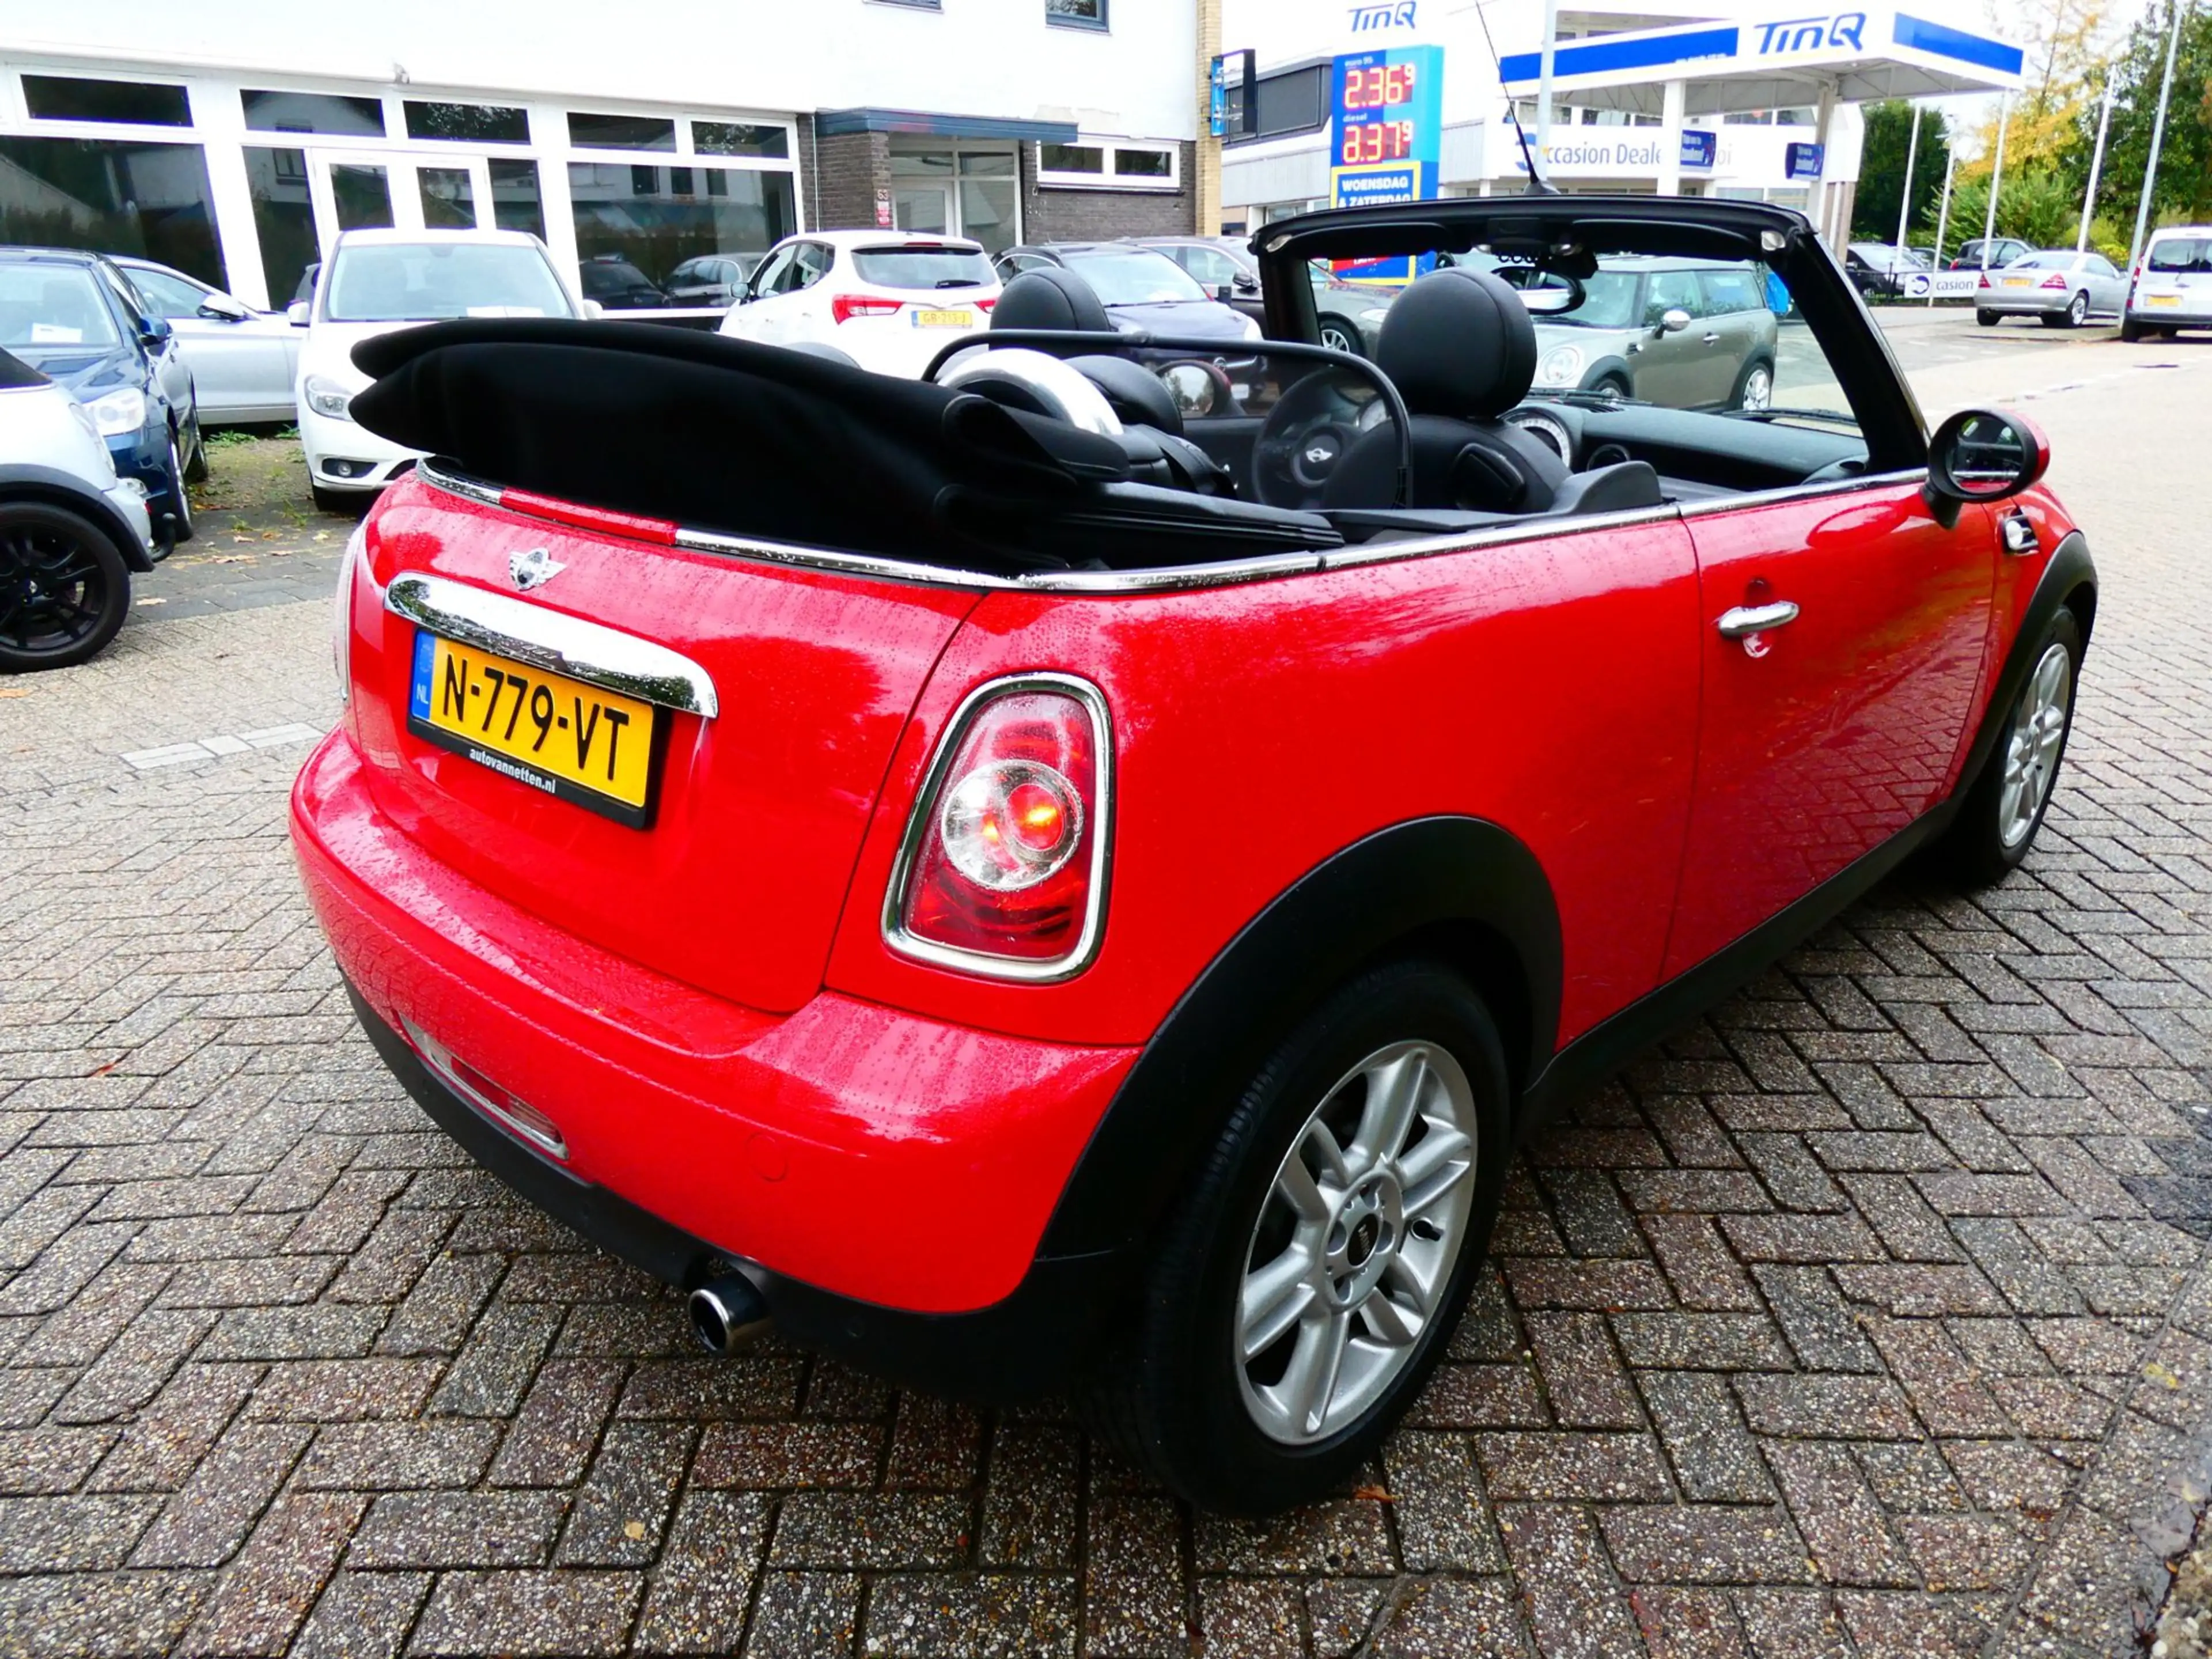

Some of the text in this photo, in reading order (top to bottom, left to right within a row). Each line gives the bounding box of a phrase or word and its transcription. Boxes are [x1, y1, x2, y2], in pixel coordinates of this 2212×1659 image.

[1347, 1, 1417, 32] TinQ
[1753, 12, 1866, 55] TinQ
[1343, 113, 1368, 122] diesel
[1546, 141, 1609, 164] ccasion
[1342, 176, 1408, 192] WOENSDAG
[416, 683, 429, 705] NL
[444, 654, 629, 781] N-779-VT
[469, 748, 556, 794] autovannetten.nl
